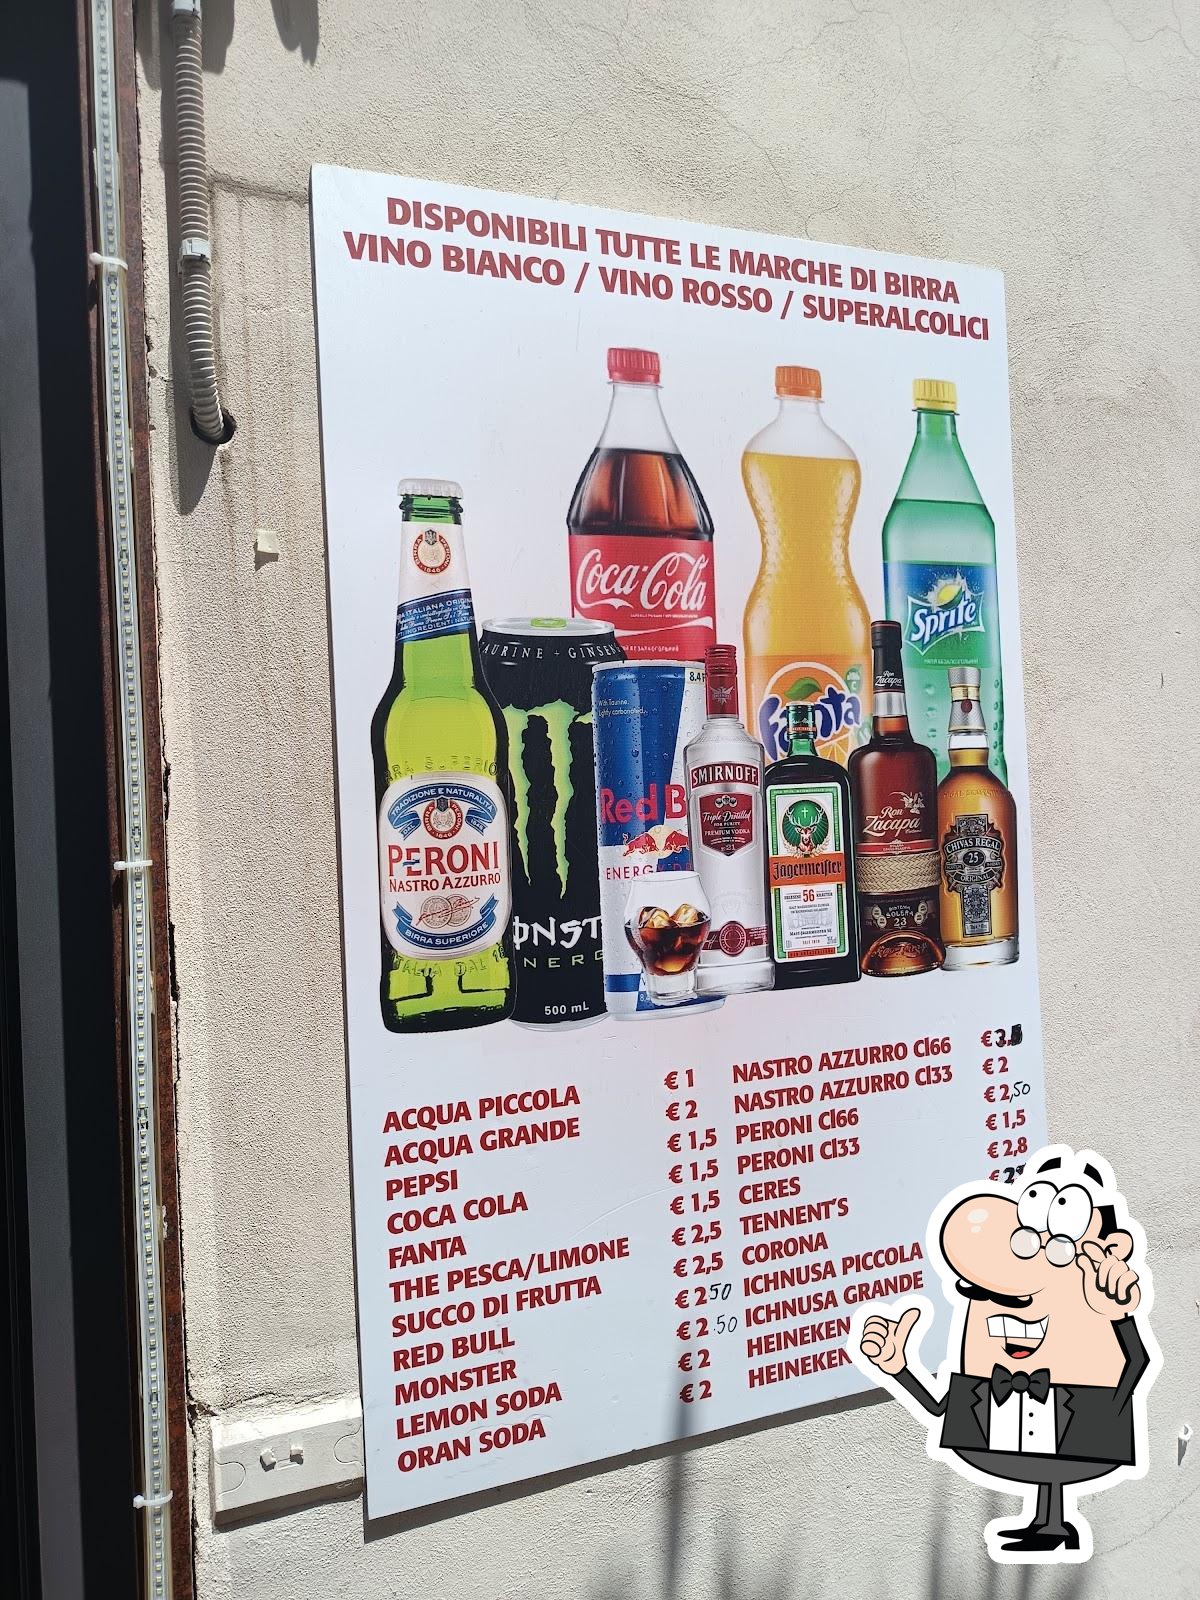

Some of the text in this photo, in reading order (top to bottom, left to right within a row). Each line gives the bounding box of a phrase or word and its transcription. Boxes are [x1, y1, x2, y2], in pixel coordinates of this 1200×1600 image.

[388, 198, 958, 303] DISPONIBILI TUTTE LE MARCHE DI BIRRA
[345, 232, 988, 340] VINO BIANCO / VINO ROSSO / SUPERALCOLICI
[911, 598, 977, 644] Sprite
[481, 641, 543, 659] AURINE
[692, 765, 758, 785] SMIRNOFF
[392, 788, 436, 816] TRADIZIONE
[600, 783, 658, 824] Red
[878, 806, 903, 819] Ron
[703, 811, 722, 824] Triple
[863, 816, 920, 837] Zacapa
[946, 837, 999, 854] CHIVAS REGAL
[968, 851, 979, 864] 25
[388, 841, 499, 876] PERONI
[389, 873, 501, 892] NASTRO AZZURRO
[802, 889, 815, 902] 56
[405, 921, 489, 945] BIRRA SUPERIORE
[513, 915, 602, 950] ONST
[894, 917, 907, 927] 23
[523, 950, 603, 968] NERG
[544, 1001, 589, 1015] 500 mL
[981, 1031, 992, 1047] €
[732, 1037, 951, 1083] NASTRO AZZURRO Cl66
[983, 1056, 1008, 1075] € 2
[664, 1069, 694, 1091] € 1
[733, 1065, 952, 1113] NASTRO AZZURRO Cl33
[984, 1086, 995, 1103] €
[383, 1086, 580, 1133] ACQUA PICCOLA
[666, 1100, 697, 1121] € 2
[986, 1109, 1025, 1130] € 1,5
[736, 1108, 858, 1144] PERONI Cl66
[385, 1117, 579, 1167] ACQUA GRANDE
[667, 1128, 717, 1152] € 1,5
[988, 1137, 1027, 1158] € 2,8
[737, 1137, 859, 1174] PERONI Cl33
[668, 1159, 718, 1184] € 1,5
[386, 1170, 458, 1201] PEPSI
[739, 1177, 800, 1204] CERES
[387, 1192, 528, 1234] COCA COLA
[670, 1190, 720, 1215] € 1,5
[740, 1198, 848, 1235] TENNENT'S
[672, 1221, 721, 1246] € 2,5
[389, 1236, 466, 1269] FANTA
[742, 1232, 828, 1265] CORONA
[390, 1238, 629, 1302] THE PESCA/LIMONE
[674, 1252, 723, 1277] € 2,5
[744, 1243, 923, 1296] ICHNUSA PICCOLA
[392, 1276, 601, 1337] SUCCO DI FRUTTA
[675, 1290, 689, 1308] €
[746, 1271, 923, 1327] ICHNUSA GRANDE
[677, 1322, 690, 1340] €
[747, 1317, 850, 1357] HEINEKEN
[393, 1328, 515, 1371] RED BULL
[678, 1349, 710, 1371] € 2
[395, 1360, 516, 1405] MONSTER
[680, 1381, 711, 1403] € 2
[396, 1383, 562, 1439] LEMON SODA
[397, 1419, 545, 1472] ORAN SODA
